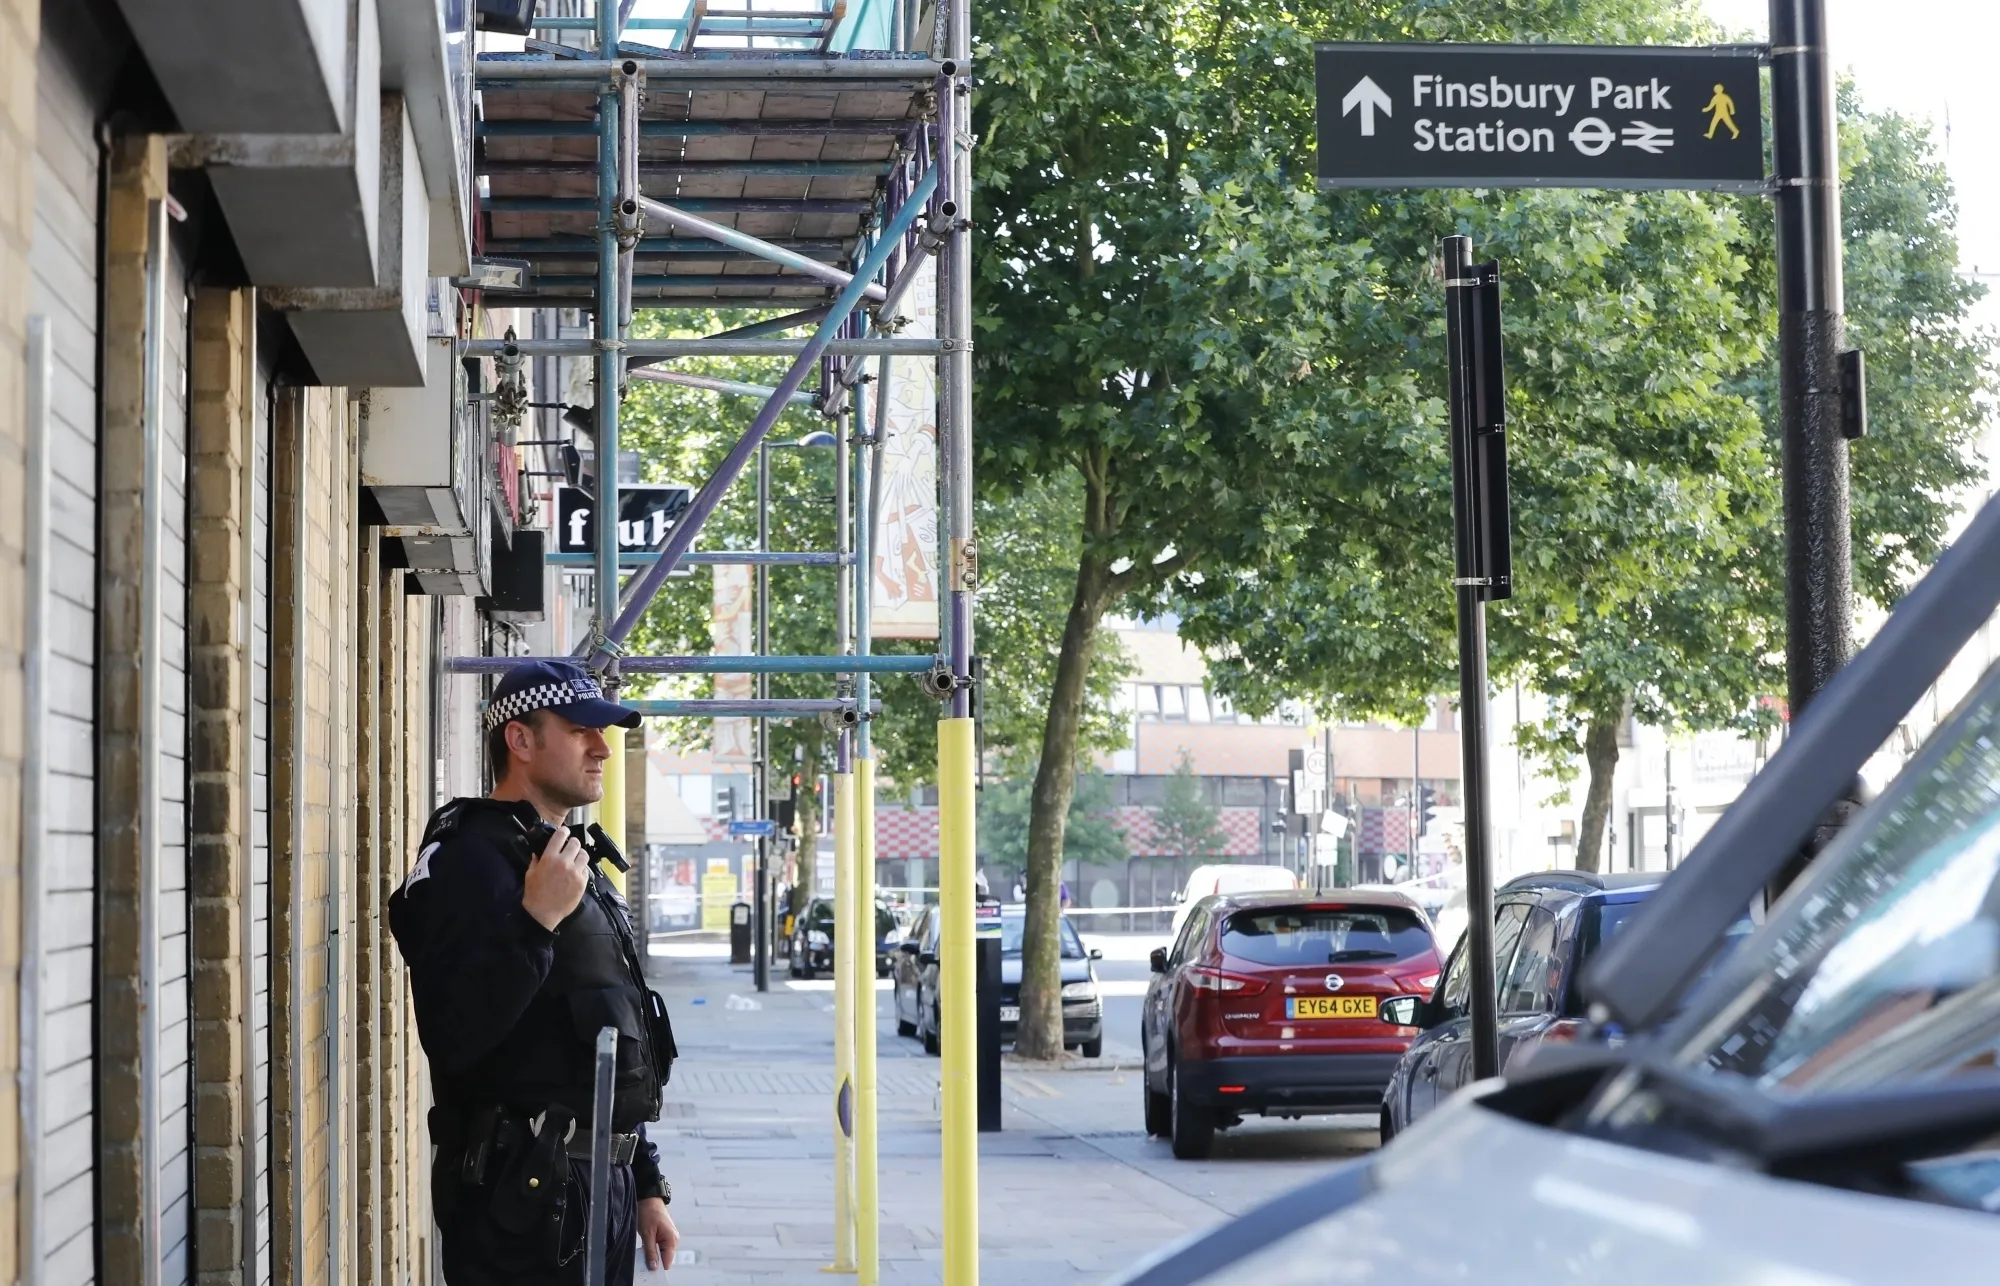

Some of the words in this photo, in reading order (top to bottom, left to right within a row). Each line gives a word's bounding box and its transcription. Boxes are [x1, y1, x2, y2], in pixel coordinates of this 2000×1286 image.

[1413, 75, 1575, 117] Finsbury
[1590, 77, 1672, 110] Park
[1413, 118, 1554, 153] Station
[1298, 999, 1338, 1014] EY64
[1343, 999, 1373, 1014] GXE
